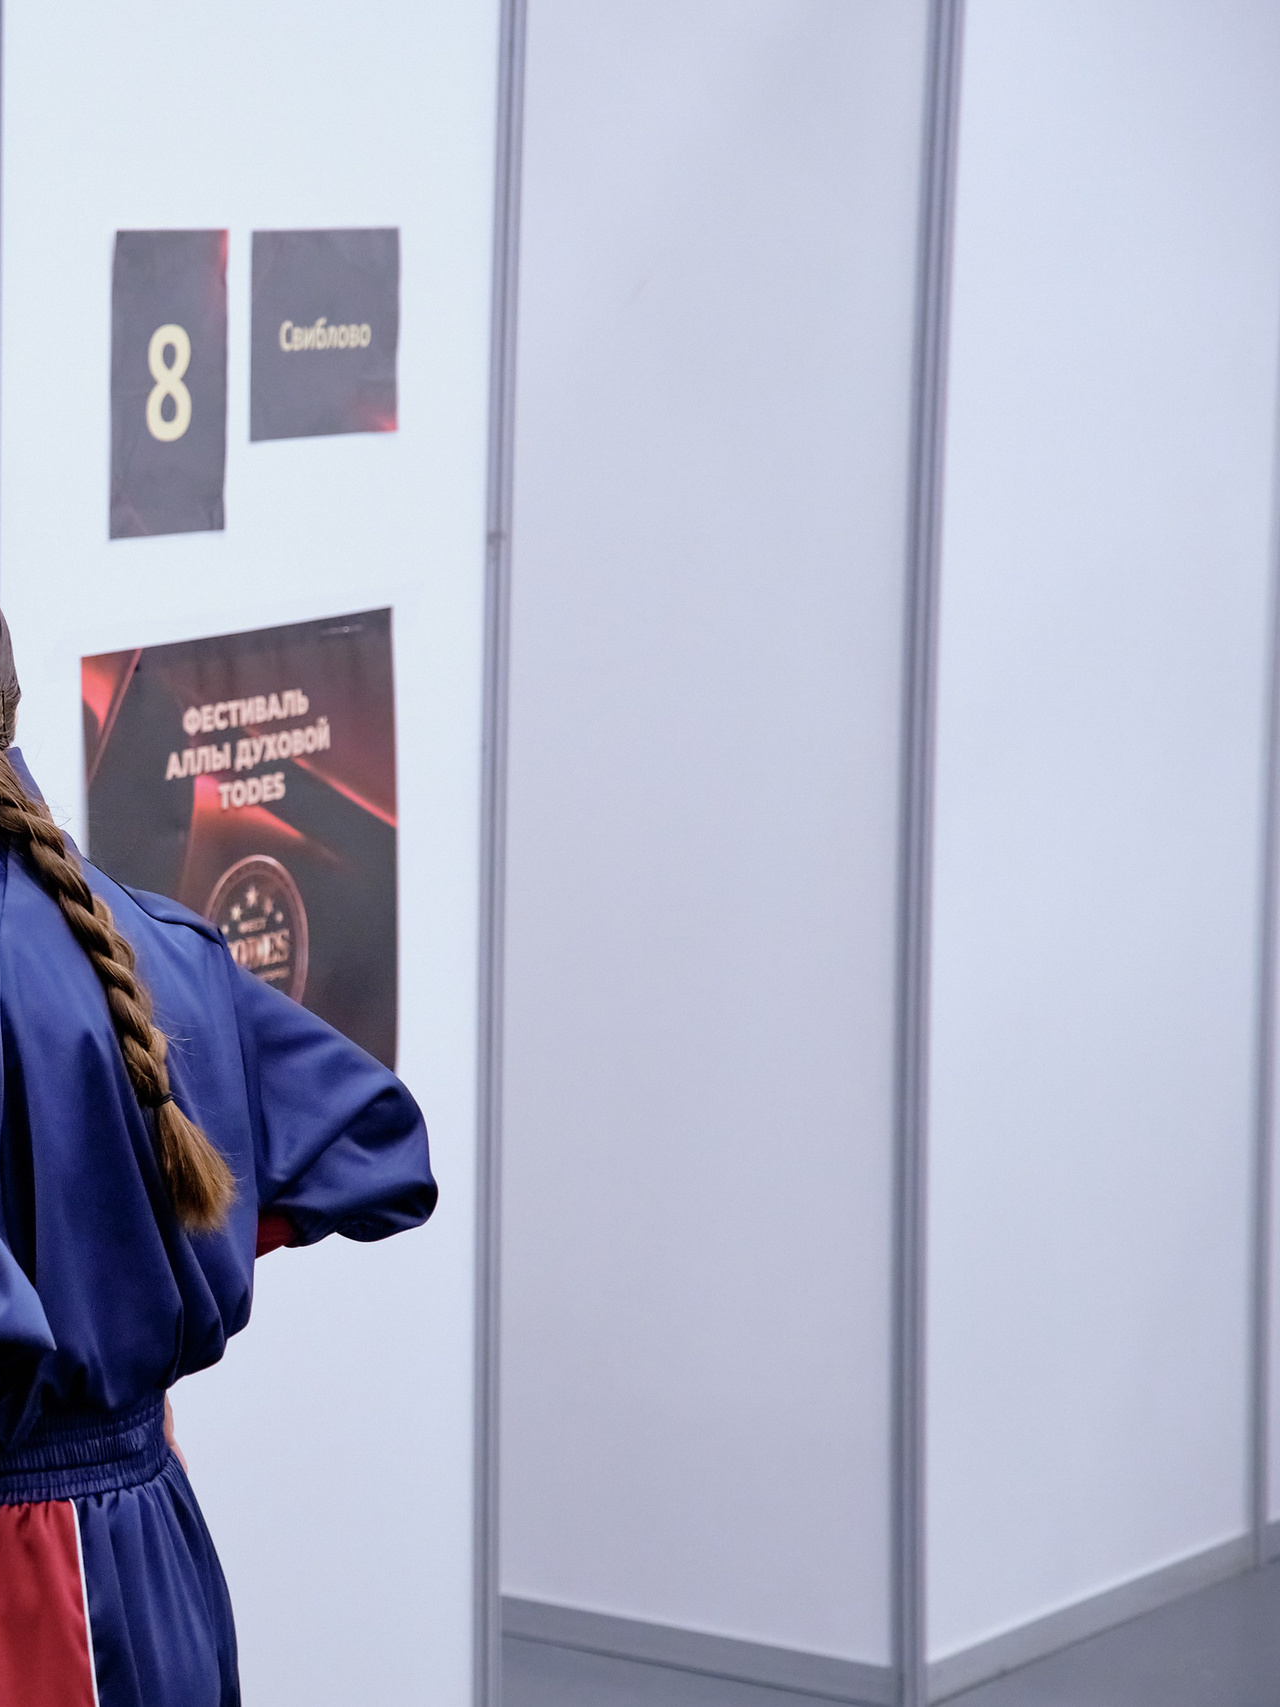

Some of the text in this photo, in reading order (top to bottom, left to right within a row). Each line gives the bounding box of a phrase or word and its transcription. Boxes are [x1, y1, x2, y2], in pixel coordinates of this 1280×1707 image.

[279, 317, 371, 351] Свиблово
[146, 323, 192, 442] 8
[182, 688, 309, 736] ФЕСТИВАЛЬ
[165, 716, 331, 781] АЛЛЫ ДУХОВОЙ
[218, 771, 286, 810] TODES
